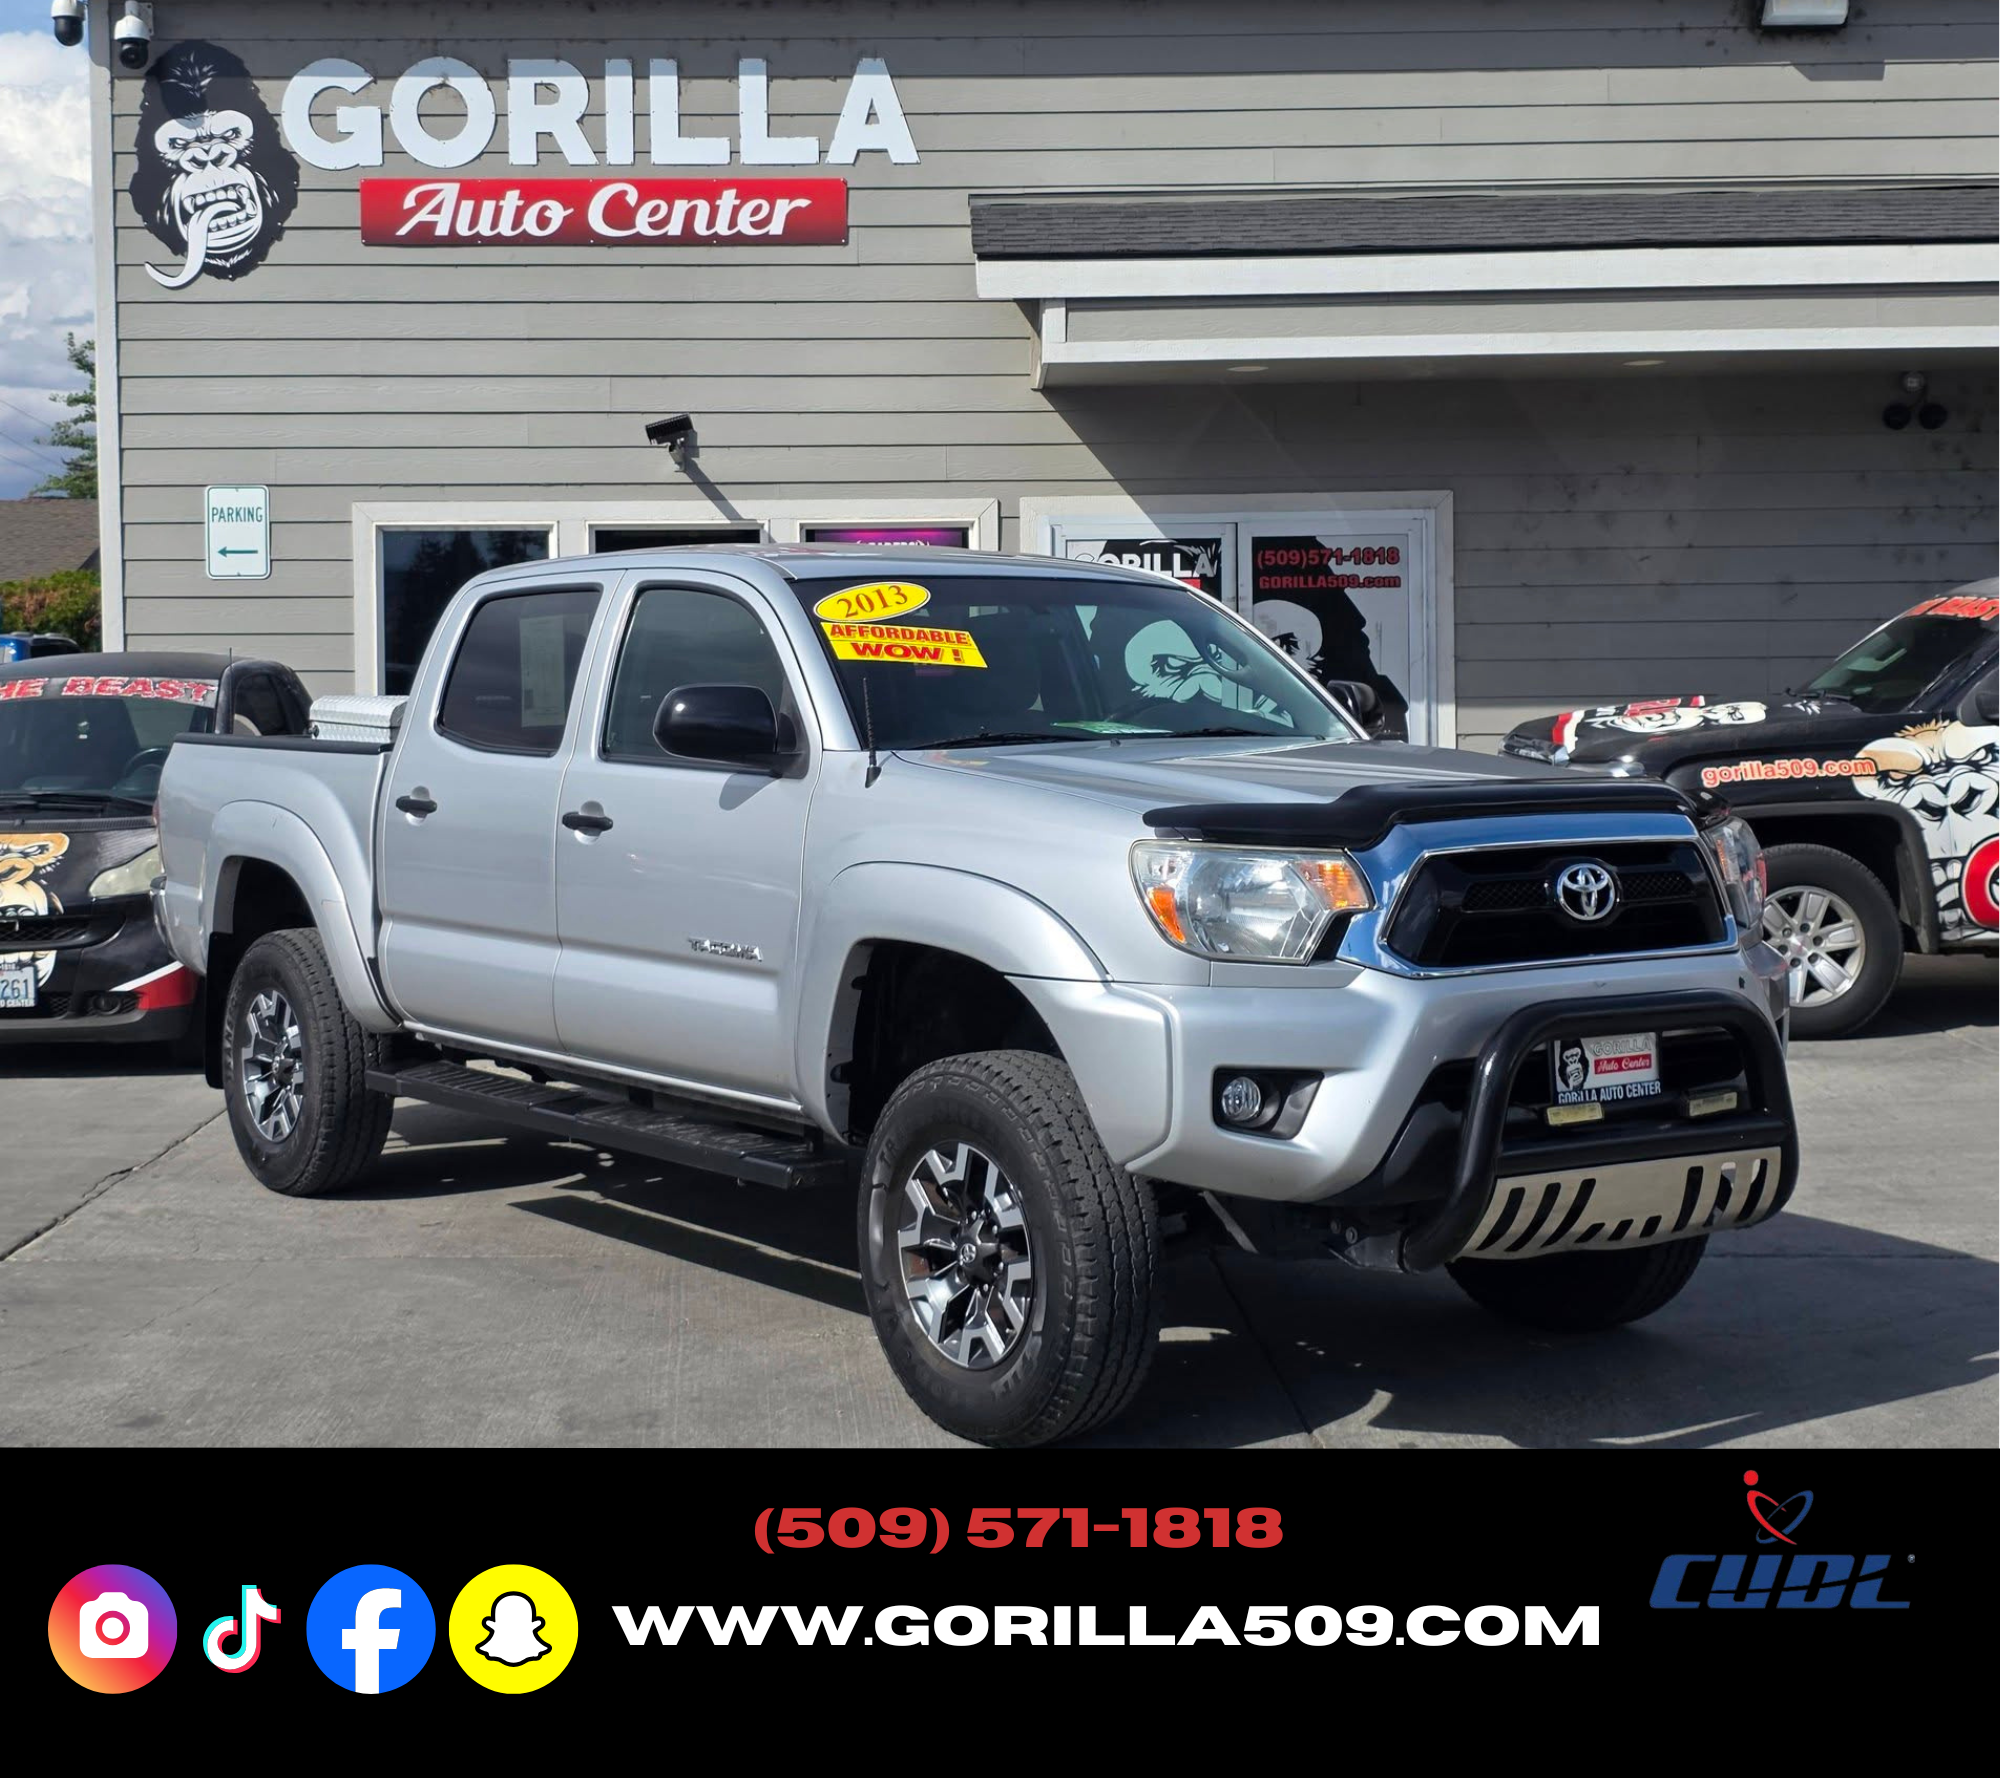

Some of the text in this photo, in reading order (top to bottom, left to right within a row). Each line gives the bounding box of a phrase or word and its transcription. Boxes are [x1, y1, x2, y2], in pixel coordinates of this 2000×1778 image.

[280, 56, 921, 170] GORILLA
[396, 182, 811, 238] Auto Center
[211, 506, 263, 523] PARKING
[1257, 547, 1400, 569] (509)571-1818
[1259, 574, 1401, 589] GORILLA509.com
[837, 585, 908, 618] 2013
[830, 623, 970, 645] AFFORDABLE
[851, 642, 943, 661] WOW
[61, 676, 219, 702] BEAST
[1702, 758, 1877, 787] gorilla509.com
[1621, 1056, 1650, 1069] Center
[1600, 1086, 1624, 1102] AUTO
[1625, 1081, 1661, 1099] CENTER
